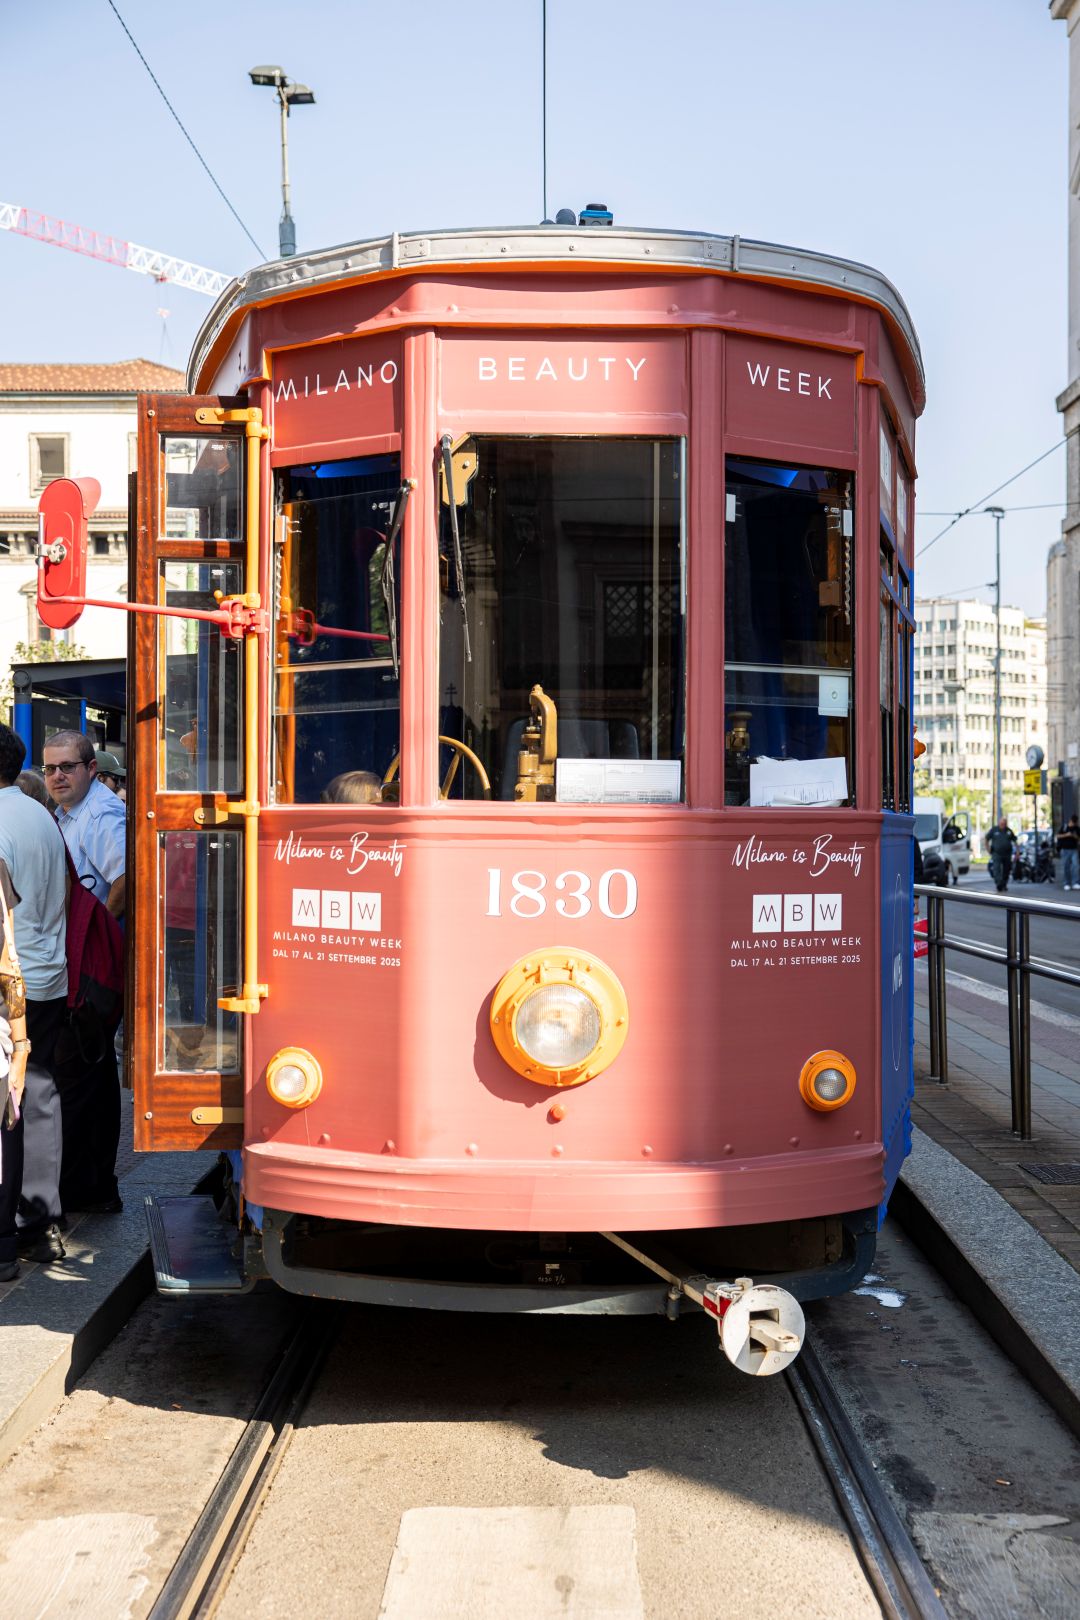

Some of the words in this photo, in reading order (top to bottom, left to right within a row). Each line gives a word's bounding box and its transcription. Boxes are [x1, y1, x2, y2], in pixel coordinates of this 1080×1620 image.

[275, 360, 398, 403] MILANO
[477, 357, 647, 382] BEAUTY
[745, 361, 832, 401] WEEK
[274, 830, 325, 865] Milano
[329, 846, 345, 860] is
[346, 831, 407, 877] Beauty
[731, 834, 788, 870] Milano
[792, 849, 808, 864] is
[809, 833, 866, 877] Beauty
[484, 867, 638, 920] 1830
[297, 899, 376, 921] MBW
[758, 903, 838, 923] MBW
[272, 931, 316, 943] MILANO
[320, 935, 365, 946] BEAUTY
[369, 938, 402, 949] WEEK
[730, 939, 778, 949] MILANO
[783, 937, 827, 948] BEAUTY
[831, 937, 862, 946] WEEK
[272, 949, 289, 958] DAL
[291, 950, 300, 959] 17
[302, 951, 314, 960] AL
[316, 952, 325, 961] 21
[328, 953, 377, 965] SETTEMBRE
[380, 957, 401, 967] 2025
[730, 959, 749, 967] DAL
[751, 958, 760, 967] 17
[764, 958, 775, 966] AL
[778, 958, 787, 966] 21
[790, 956, 838, 965] SETTEMBRE
[841, 955, 861, 964] 2025
